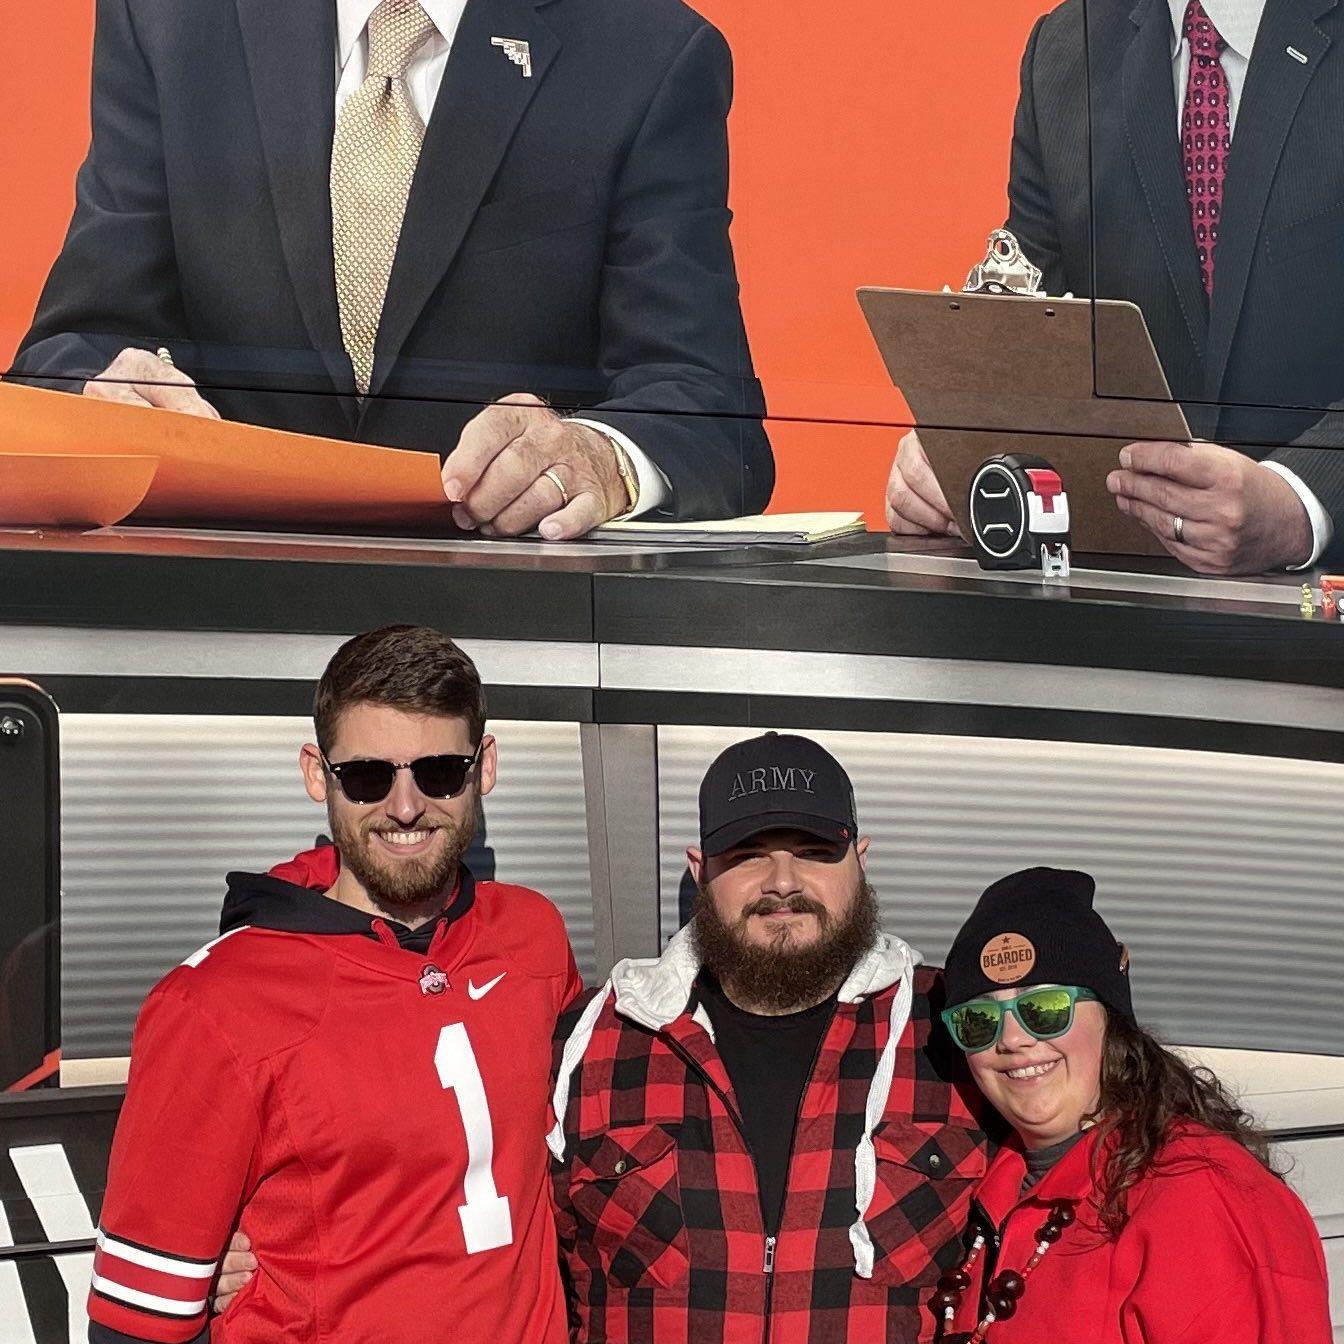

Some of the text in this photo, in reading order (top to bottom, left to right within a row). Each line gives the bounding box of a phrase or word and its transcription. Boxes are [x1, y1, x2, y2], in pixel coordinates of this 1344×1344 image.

[727, 766, 817, 802] ARMY
[982, 948, 1033, 969] BEARDED
[433, 1021, 514, 1256] 1
